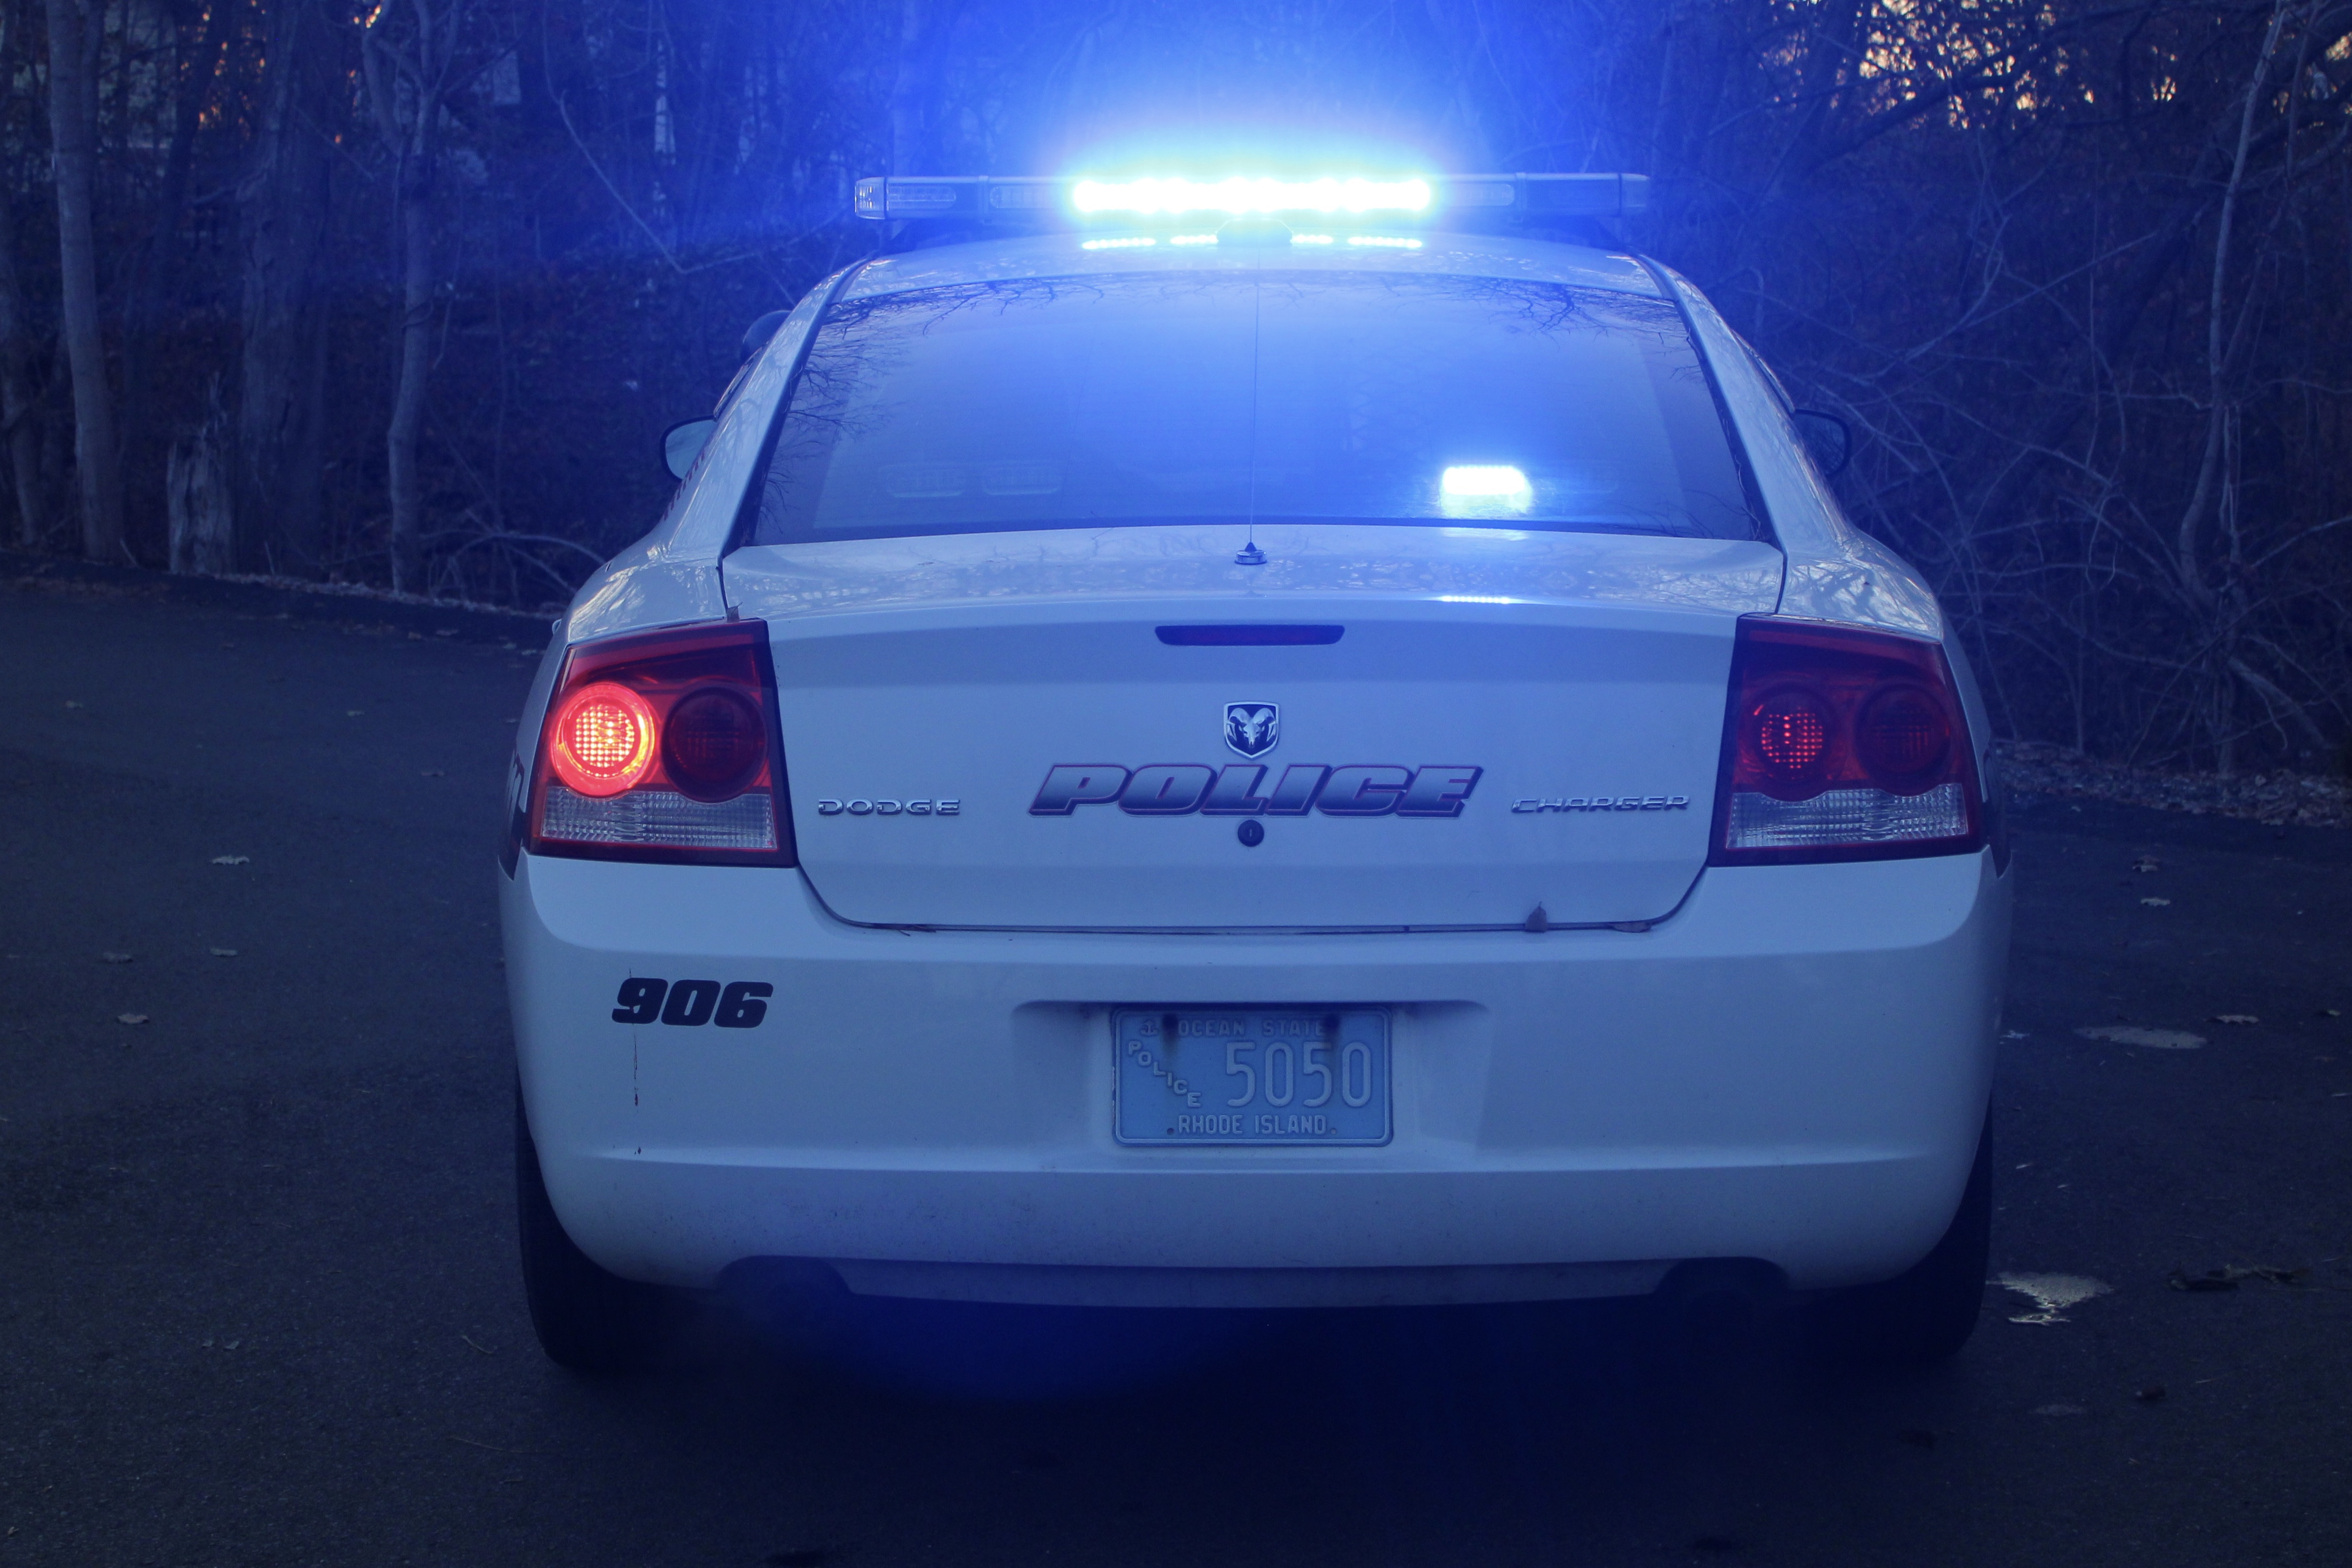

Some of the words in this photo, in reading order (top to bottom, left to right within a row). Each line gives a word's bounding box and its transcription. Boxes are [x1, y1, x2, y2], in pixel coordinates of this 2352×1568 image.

[818, 798, 959, 815] DODGE
[1028, 763, 1484, 818] POLICE
[1511, 795, 1690, 813] CHARGER
[612, 977, 773, 1028] 906
[1178, 1019, 1245, 1036] OCEAN
[1262, 1019, 1326, 1036] STATE
[1128, 1041, 1201, 1107] POLICE
[1227, 1042, 1371, 1107] 5050
[1179, 1115, 1243, 1134] RHODE
[1255, 1115, 1326, 1134] ISLAND
